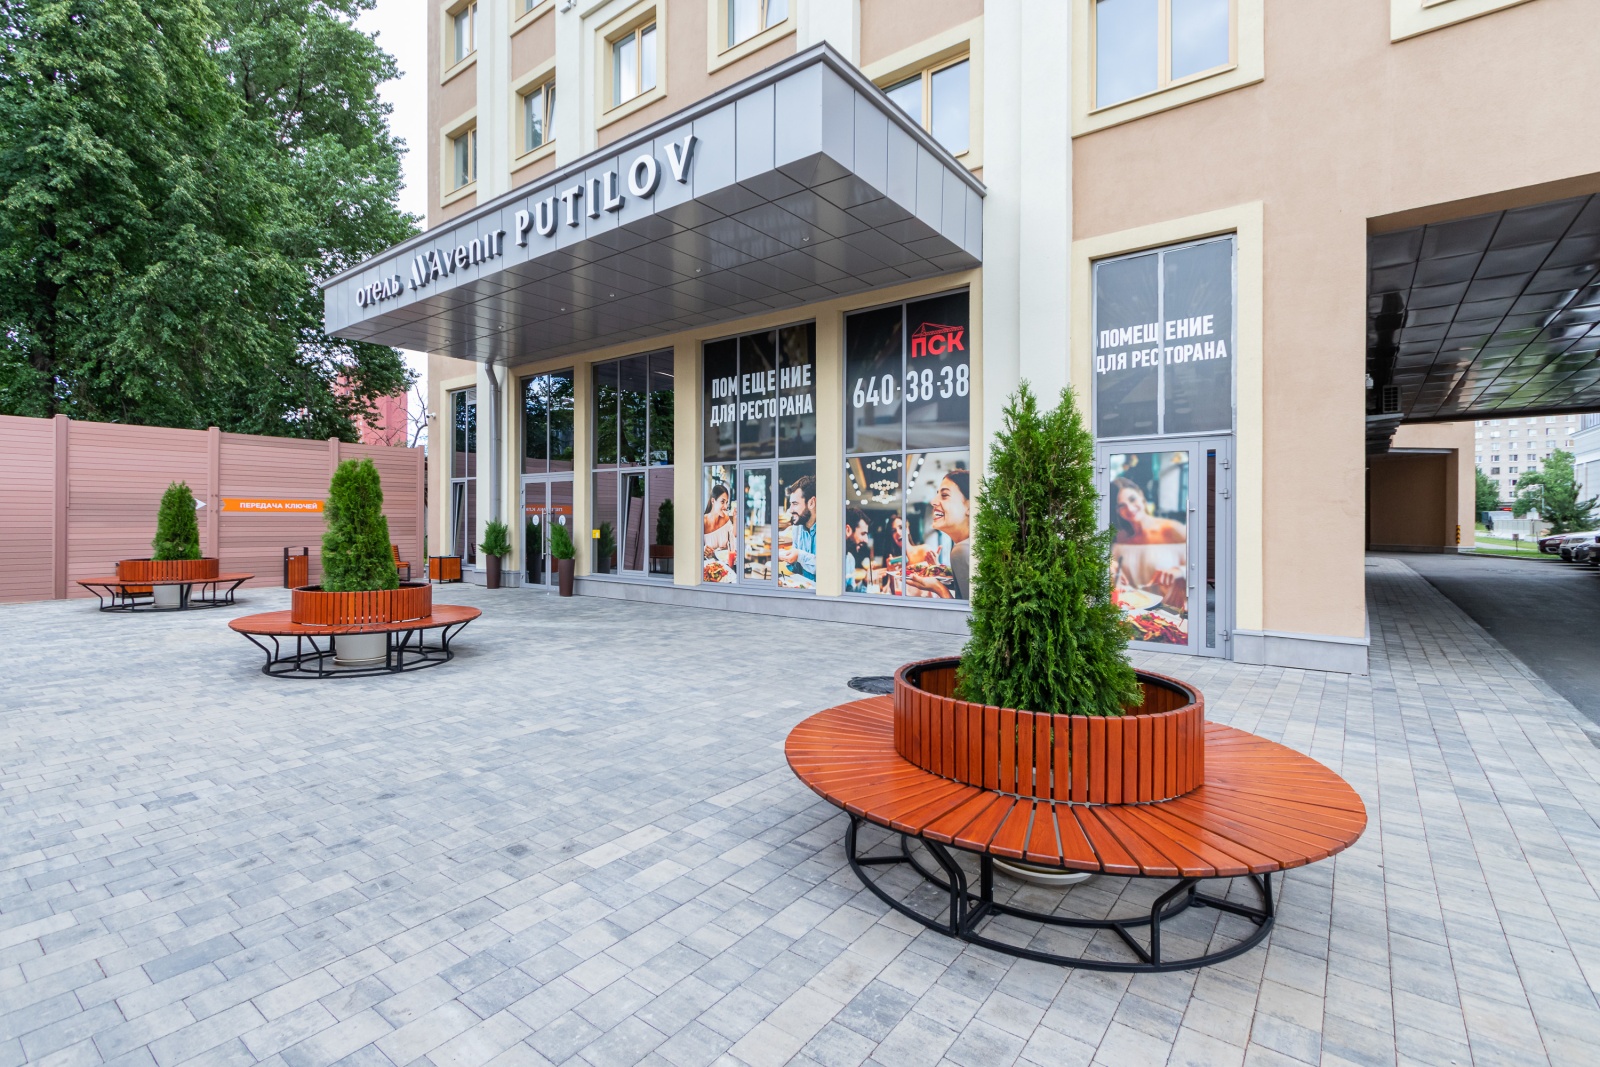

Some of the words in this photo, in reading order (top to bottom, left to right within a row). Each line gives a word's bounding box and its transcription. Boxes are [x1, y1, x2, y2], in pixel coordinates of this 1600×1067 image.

[356, 275, 404, 308] отель
[514, 134, 699, 248] PUTILOV
[911, 330, 965, 358] ПСК
[1100, 314, 1214, 349] ПОМЕЩЕНИЕ
[1096, 352, 1127, 375] ДЛЯ
[1131, 339, 1228, 369] РЕСТОРАНА
[711, 363, 812, 399] ПОМЕЩЕНИЕ
[710, 402, 736, 428] ДЛЯ
[739, 393, 813, 421] РЕСТОРАНА
[285, 502, 318, 510] КЛЮЧЕЙ
